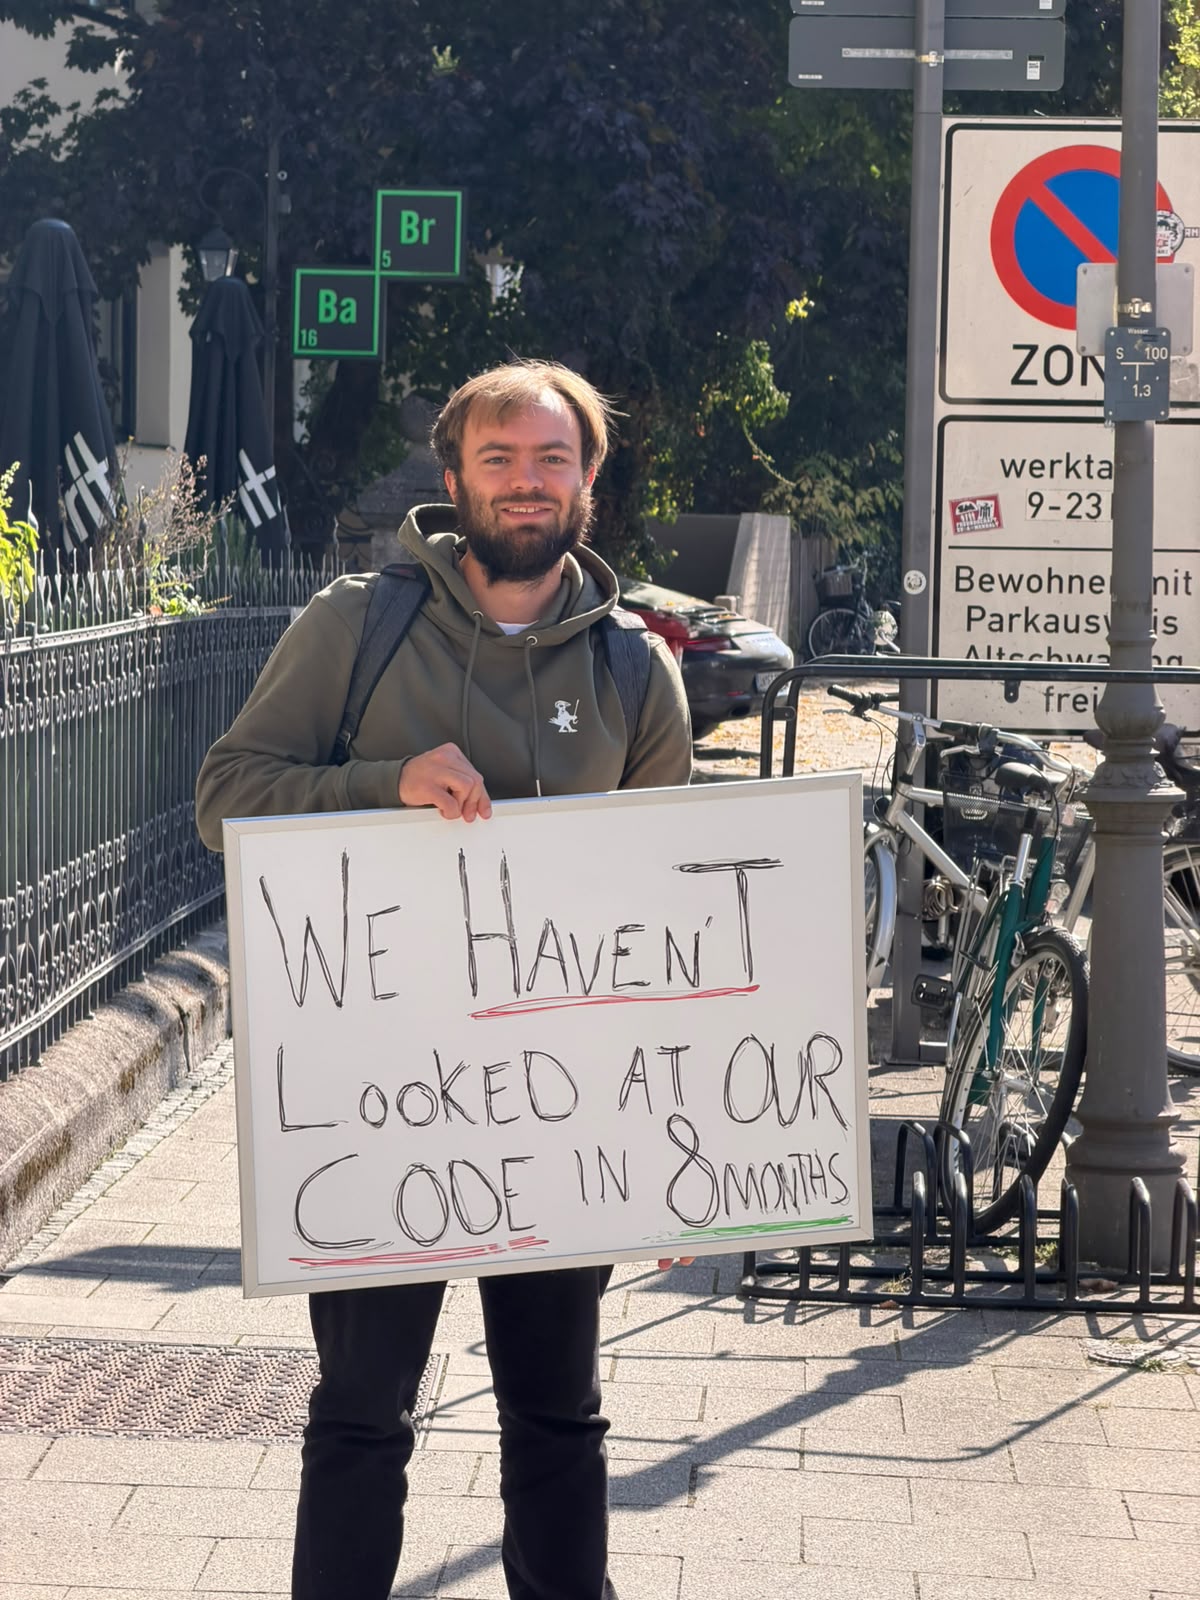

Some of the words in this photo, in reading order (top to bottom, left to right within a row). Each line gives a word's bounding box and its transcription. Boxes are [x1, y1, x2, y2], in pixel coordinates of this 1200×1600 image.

[401, 210, 436, 245] Br
[382, 250, 391, 268] 5
[318, 289, 357, 324] Ba
[301, 329, 318, 347] 16
[1116, 347, 1125, 360] S
[1144, 346, 1169, 360] 100
[1010, 344, 1105, 386] ZON
[1132, 384, 1152, 398] 1.3
[1000, 451, 1113, 479] werkta
[955, 565, 1112, 595] Bewohne
[966, 605, 1179, 636] Parkausis
[1044, 686, 1099, 714] frei
[617, 1045, 692, 1115] AT
[723, 1032, 852, 1132] OUR
[295, 1152, 537, 1249] CODE
[573, 1145, 630, 1206] IN
